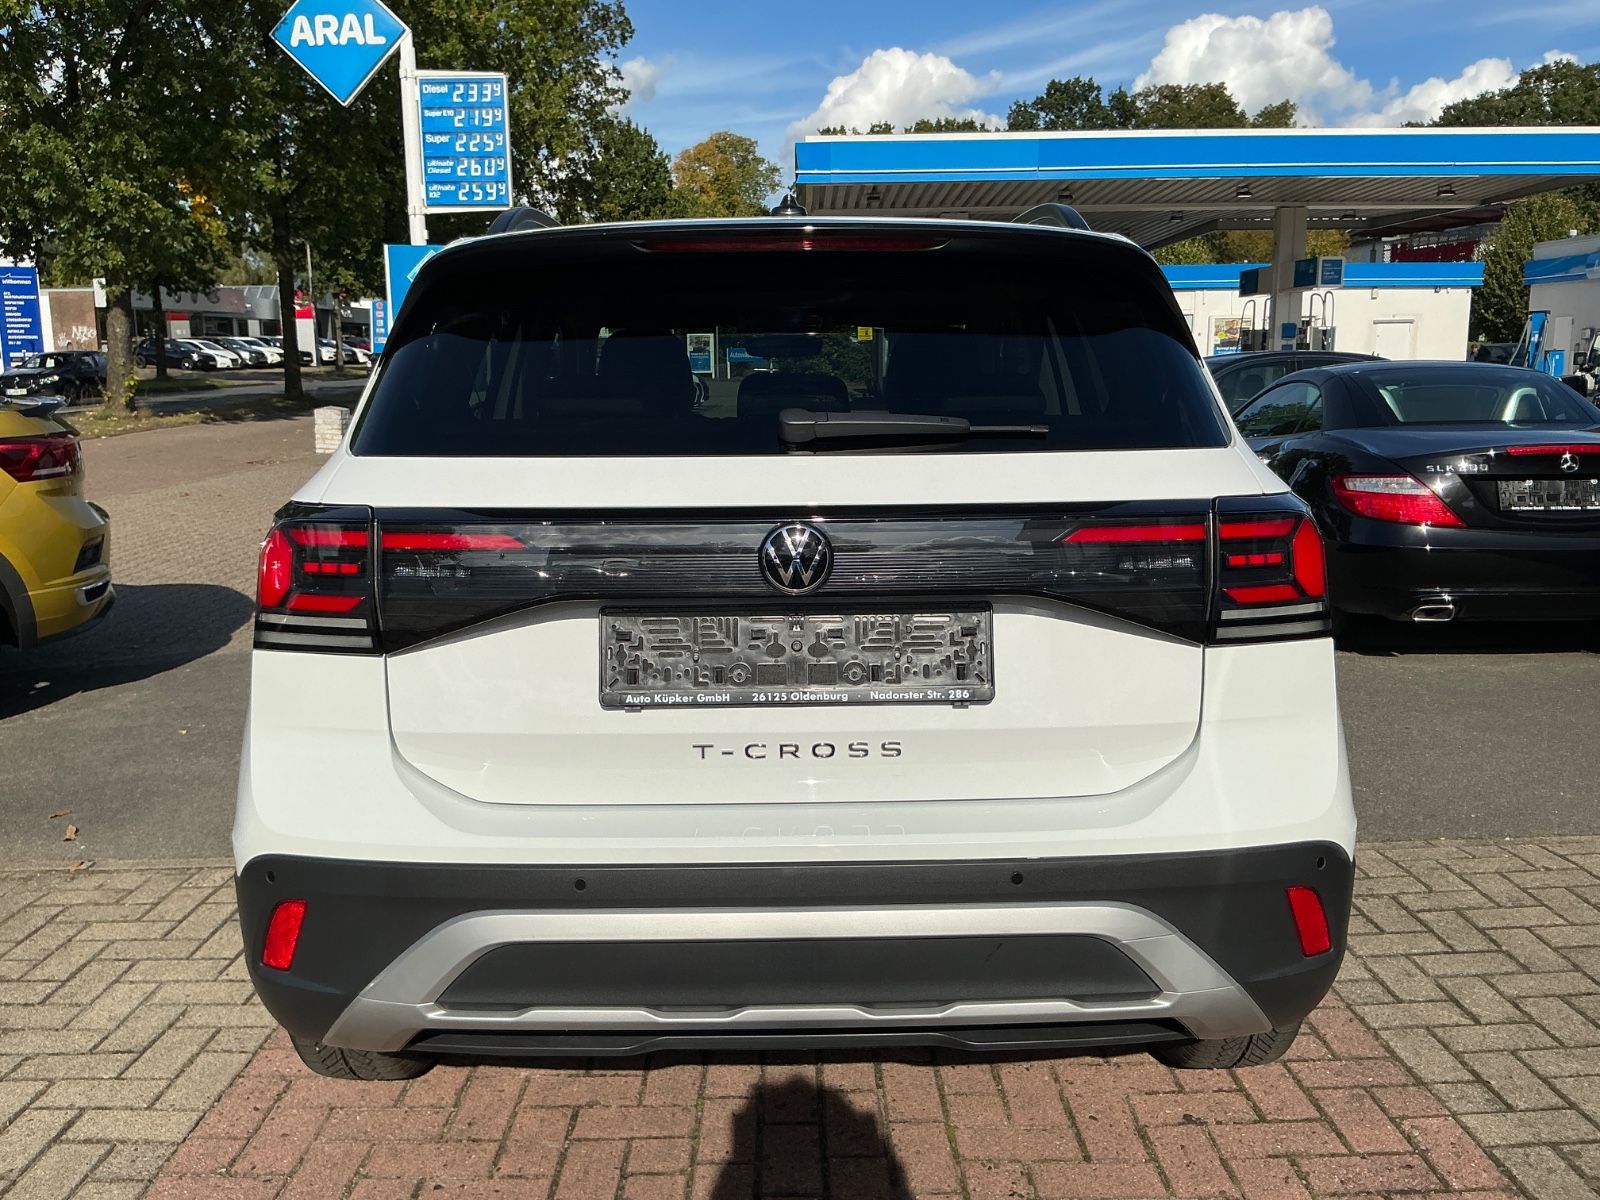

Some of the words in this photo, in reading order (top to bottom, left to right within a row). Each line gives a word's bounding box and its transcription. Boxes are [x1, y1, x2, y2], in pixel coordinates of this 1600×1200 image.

[290, 13, 387, 48] ARAL
[422, 84, 449, 94] Diesel
[424, 109, 442, 117] Super
[443, 109, 455, 117] E10
[425, 133, 451, 144] Super
[429, 191, 441, 199] 102
[1425, 464, 1455, 472] SLK
[763, 525, 830, 592] VW
[625, 694, 651, 704] Auto
[654, 693, 694, 704] Küpker
[696, 693, 730, 703] GmbH
[751, 692, 788, 702] 26125
[790, 691, 849, 702] Oldenburg
[869, 690, 925, 700] Nadorster
[926, 690, 946, 700] Str.
[948, 689, 970, 699] 286
[691, 741, 902, 760] T-CROSS
